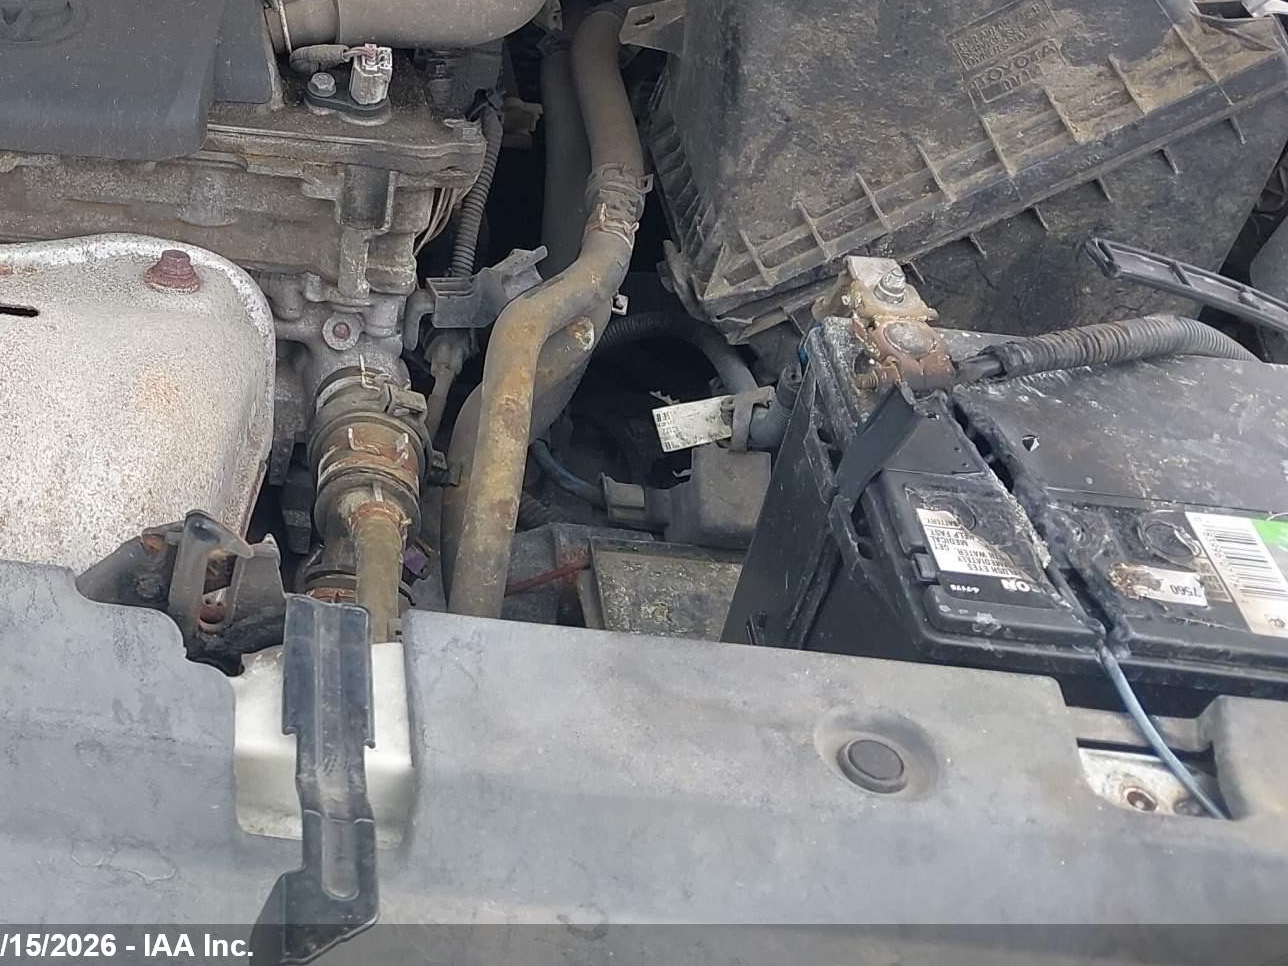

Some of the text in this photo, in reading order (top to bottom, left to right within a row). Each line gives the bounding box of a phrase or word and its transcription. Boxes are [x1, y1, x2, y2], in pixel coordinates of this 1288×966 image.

[975, 44, 1058, 86] TOYOTA
[931, 536, 969, 546] MEDICAL
[934, 543, 950, 551] GET
[968, 564, 990, 573] EYES
